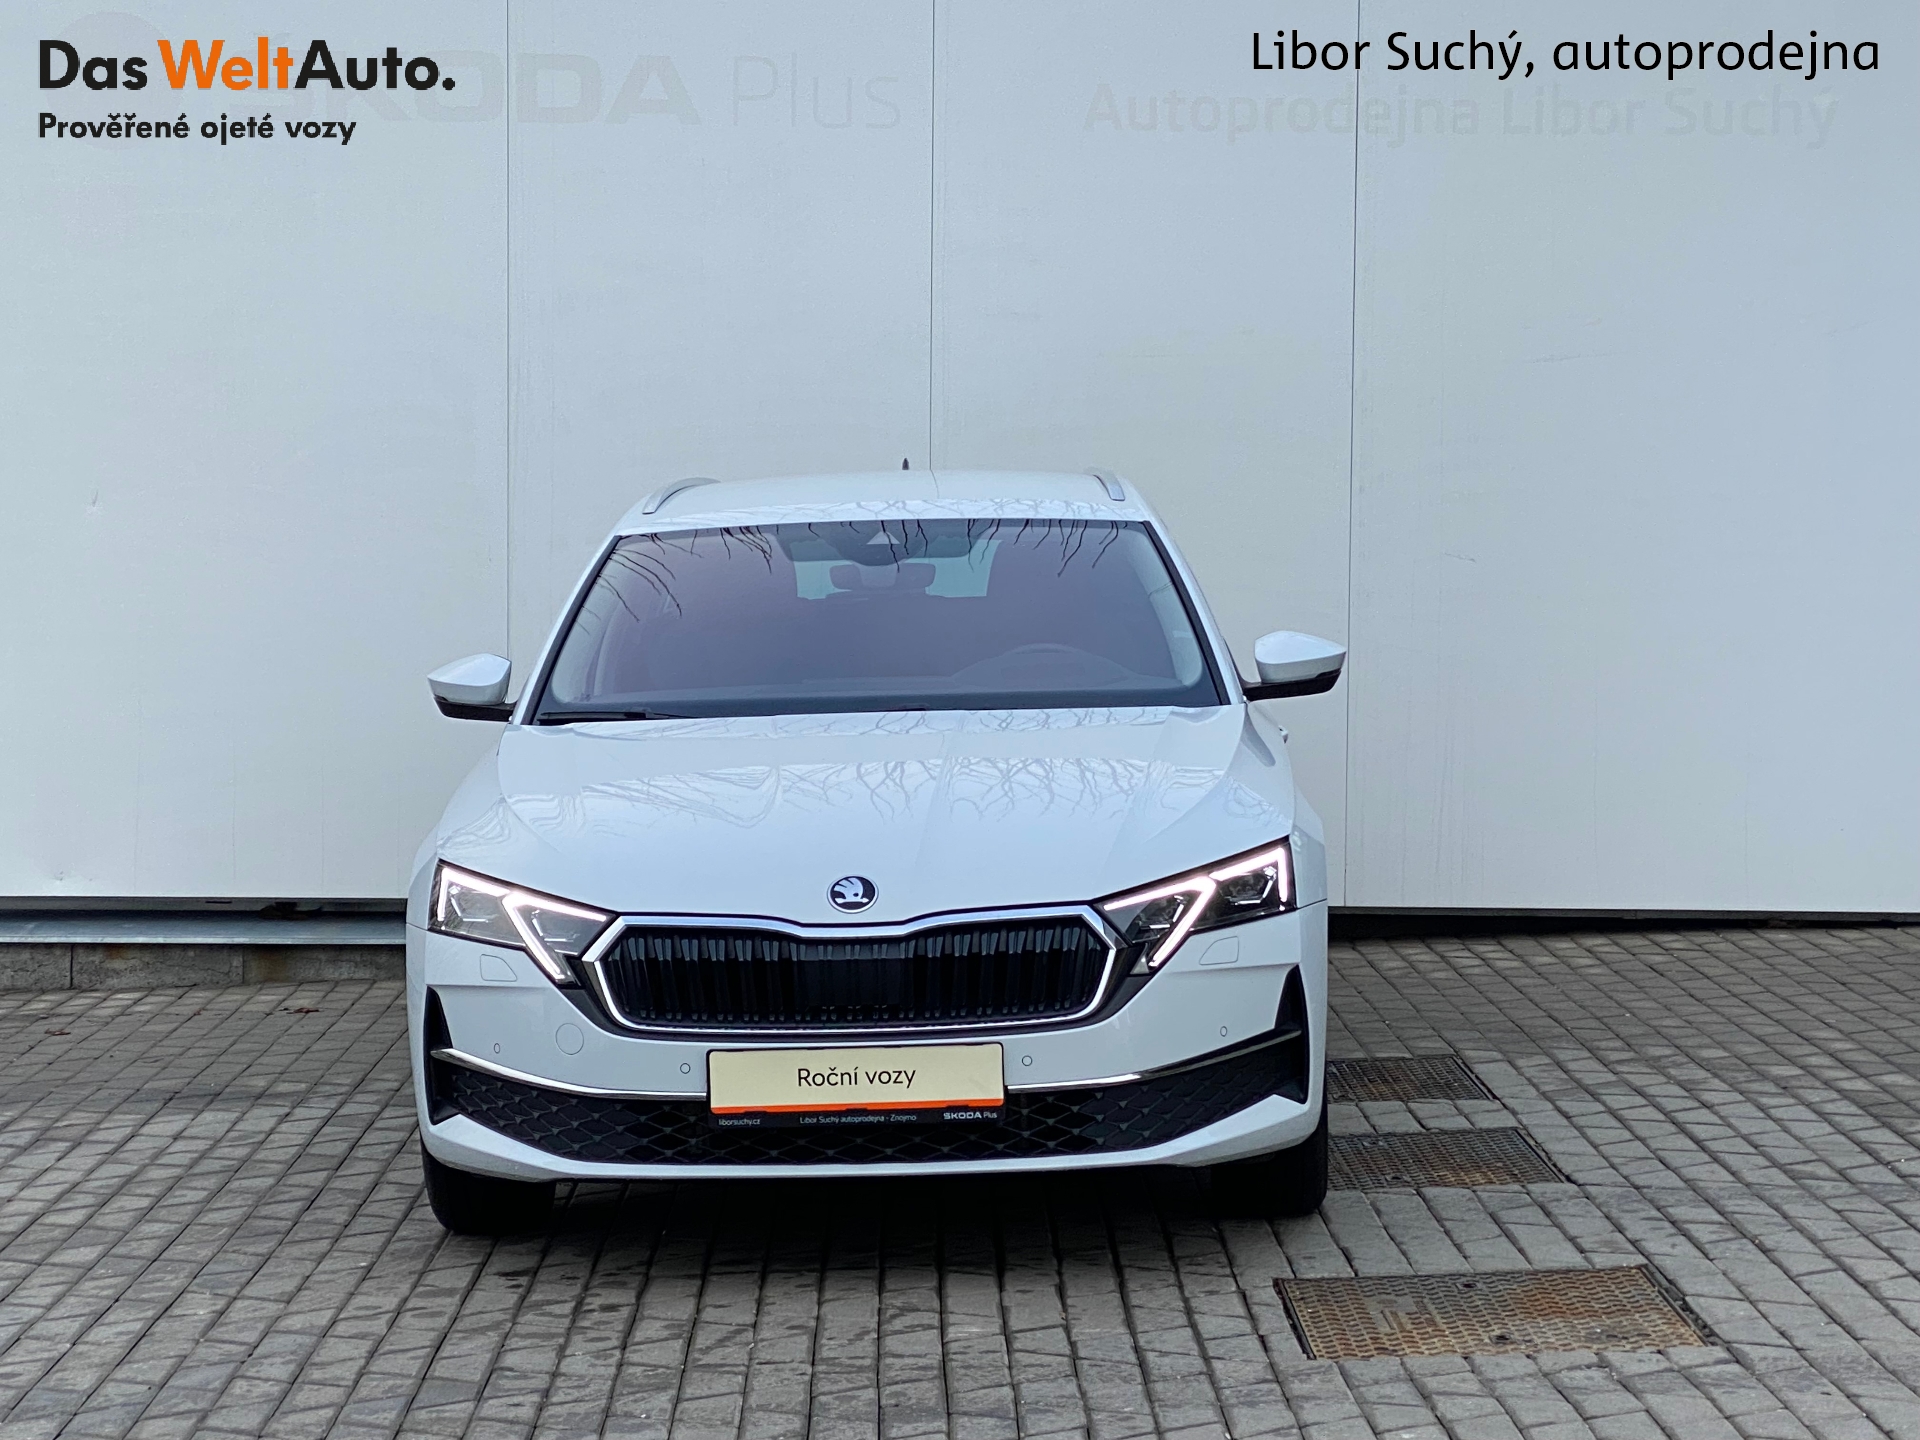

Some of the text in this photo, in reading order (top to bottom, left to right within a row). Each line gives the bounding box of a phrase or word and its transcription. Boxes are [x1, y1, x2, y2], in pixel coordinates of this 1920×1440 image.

[732, 51, 901, 130] Plus
[1083, 79, 1841, 149] Autoprodejna Libor Suchý
[797, 1066, 917, 1089] Roční vozy
[890, 1113, 917, 1122] Znojmo
